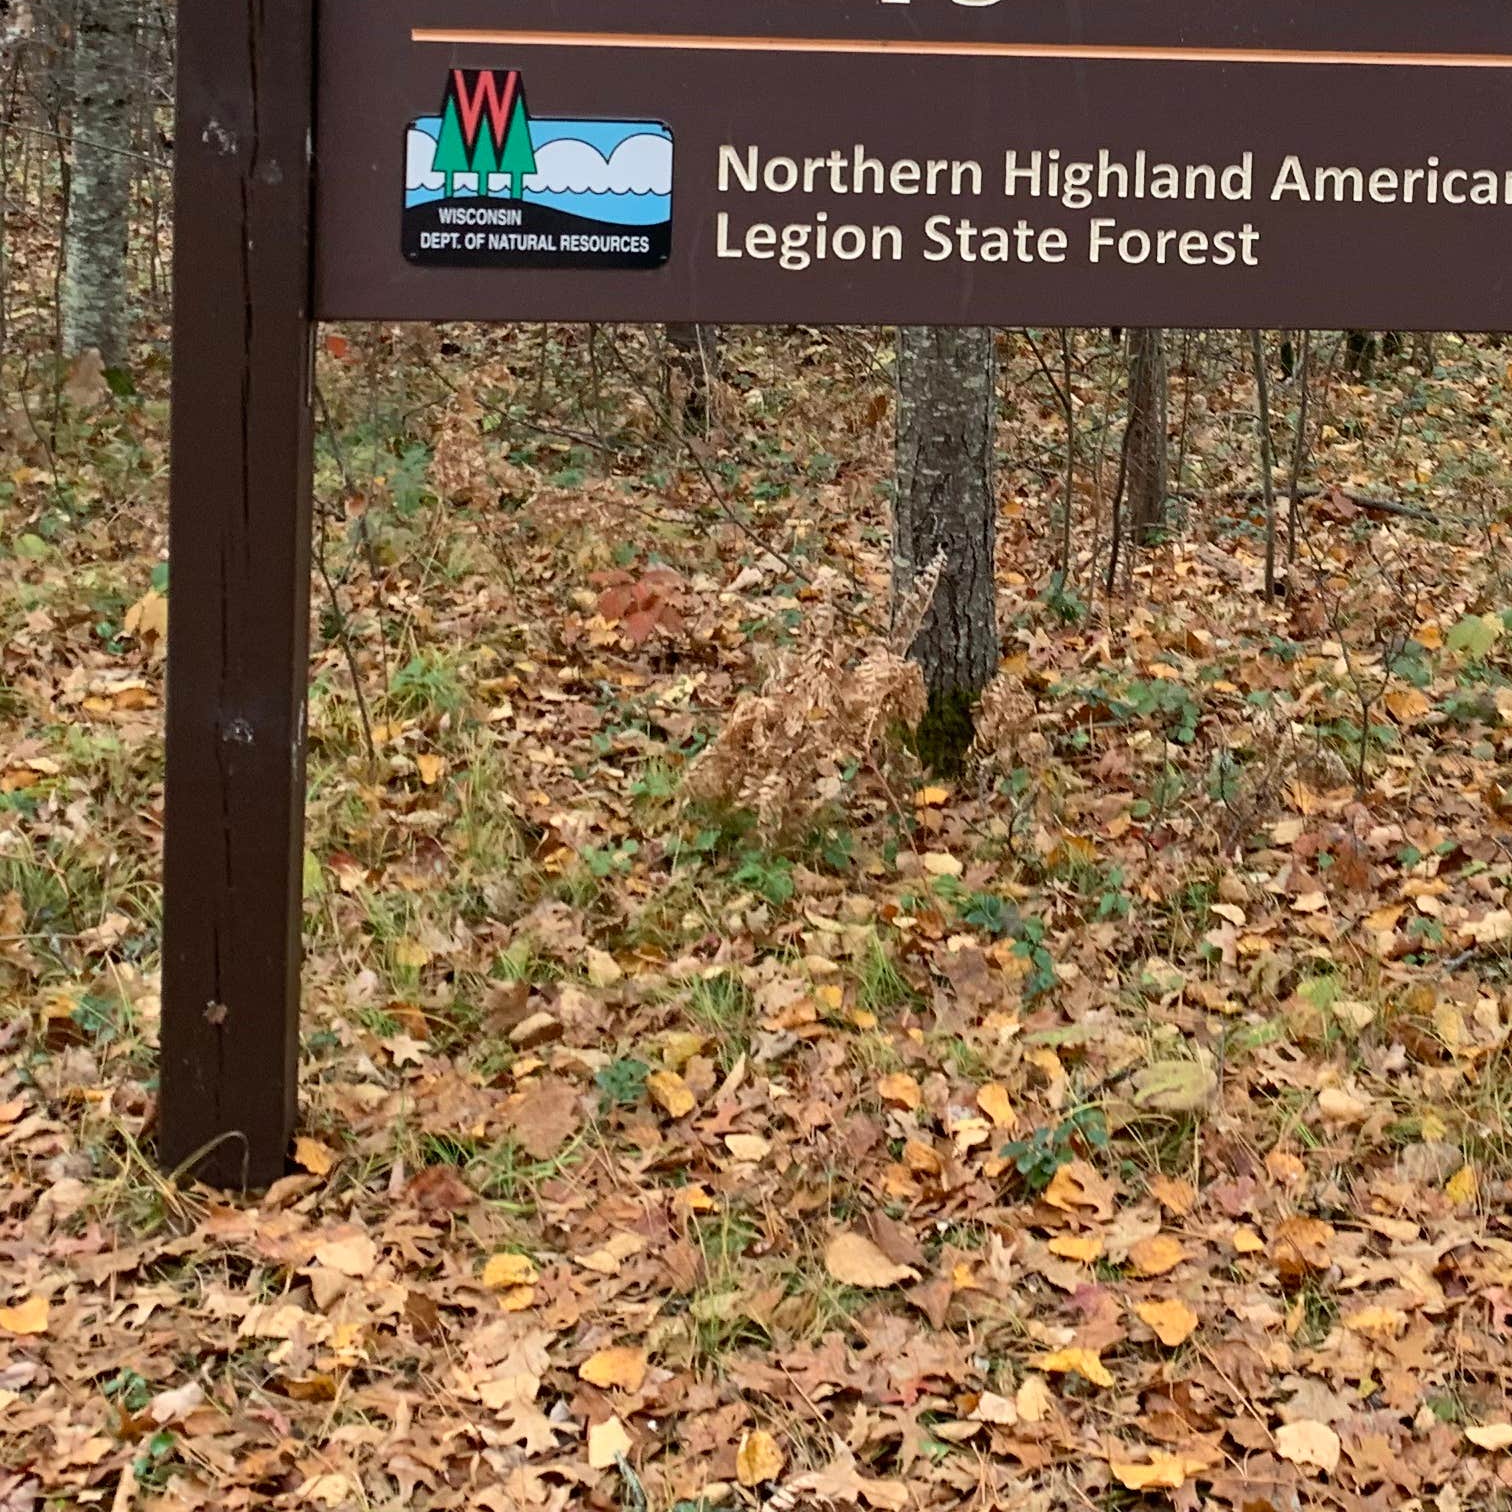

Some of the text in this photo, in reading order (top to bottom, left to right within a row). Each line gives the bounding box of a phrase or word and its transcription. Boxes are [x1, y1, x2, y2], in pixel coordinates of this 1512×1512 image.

[453, 69, 518, 148] W
[717, 144, 983, 196] Northern
[1003, 148, 1254, 210] Highland
[420, 232, 650, 253] DEPT. OF NATURAL RESOURCES
[438, 207, 522, 226] WISCONSIN
[716, 210, 1261, 272] Legion State Forest
